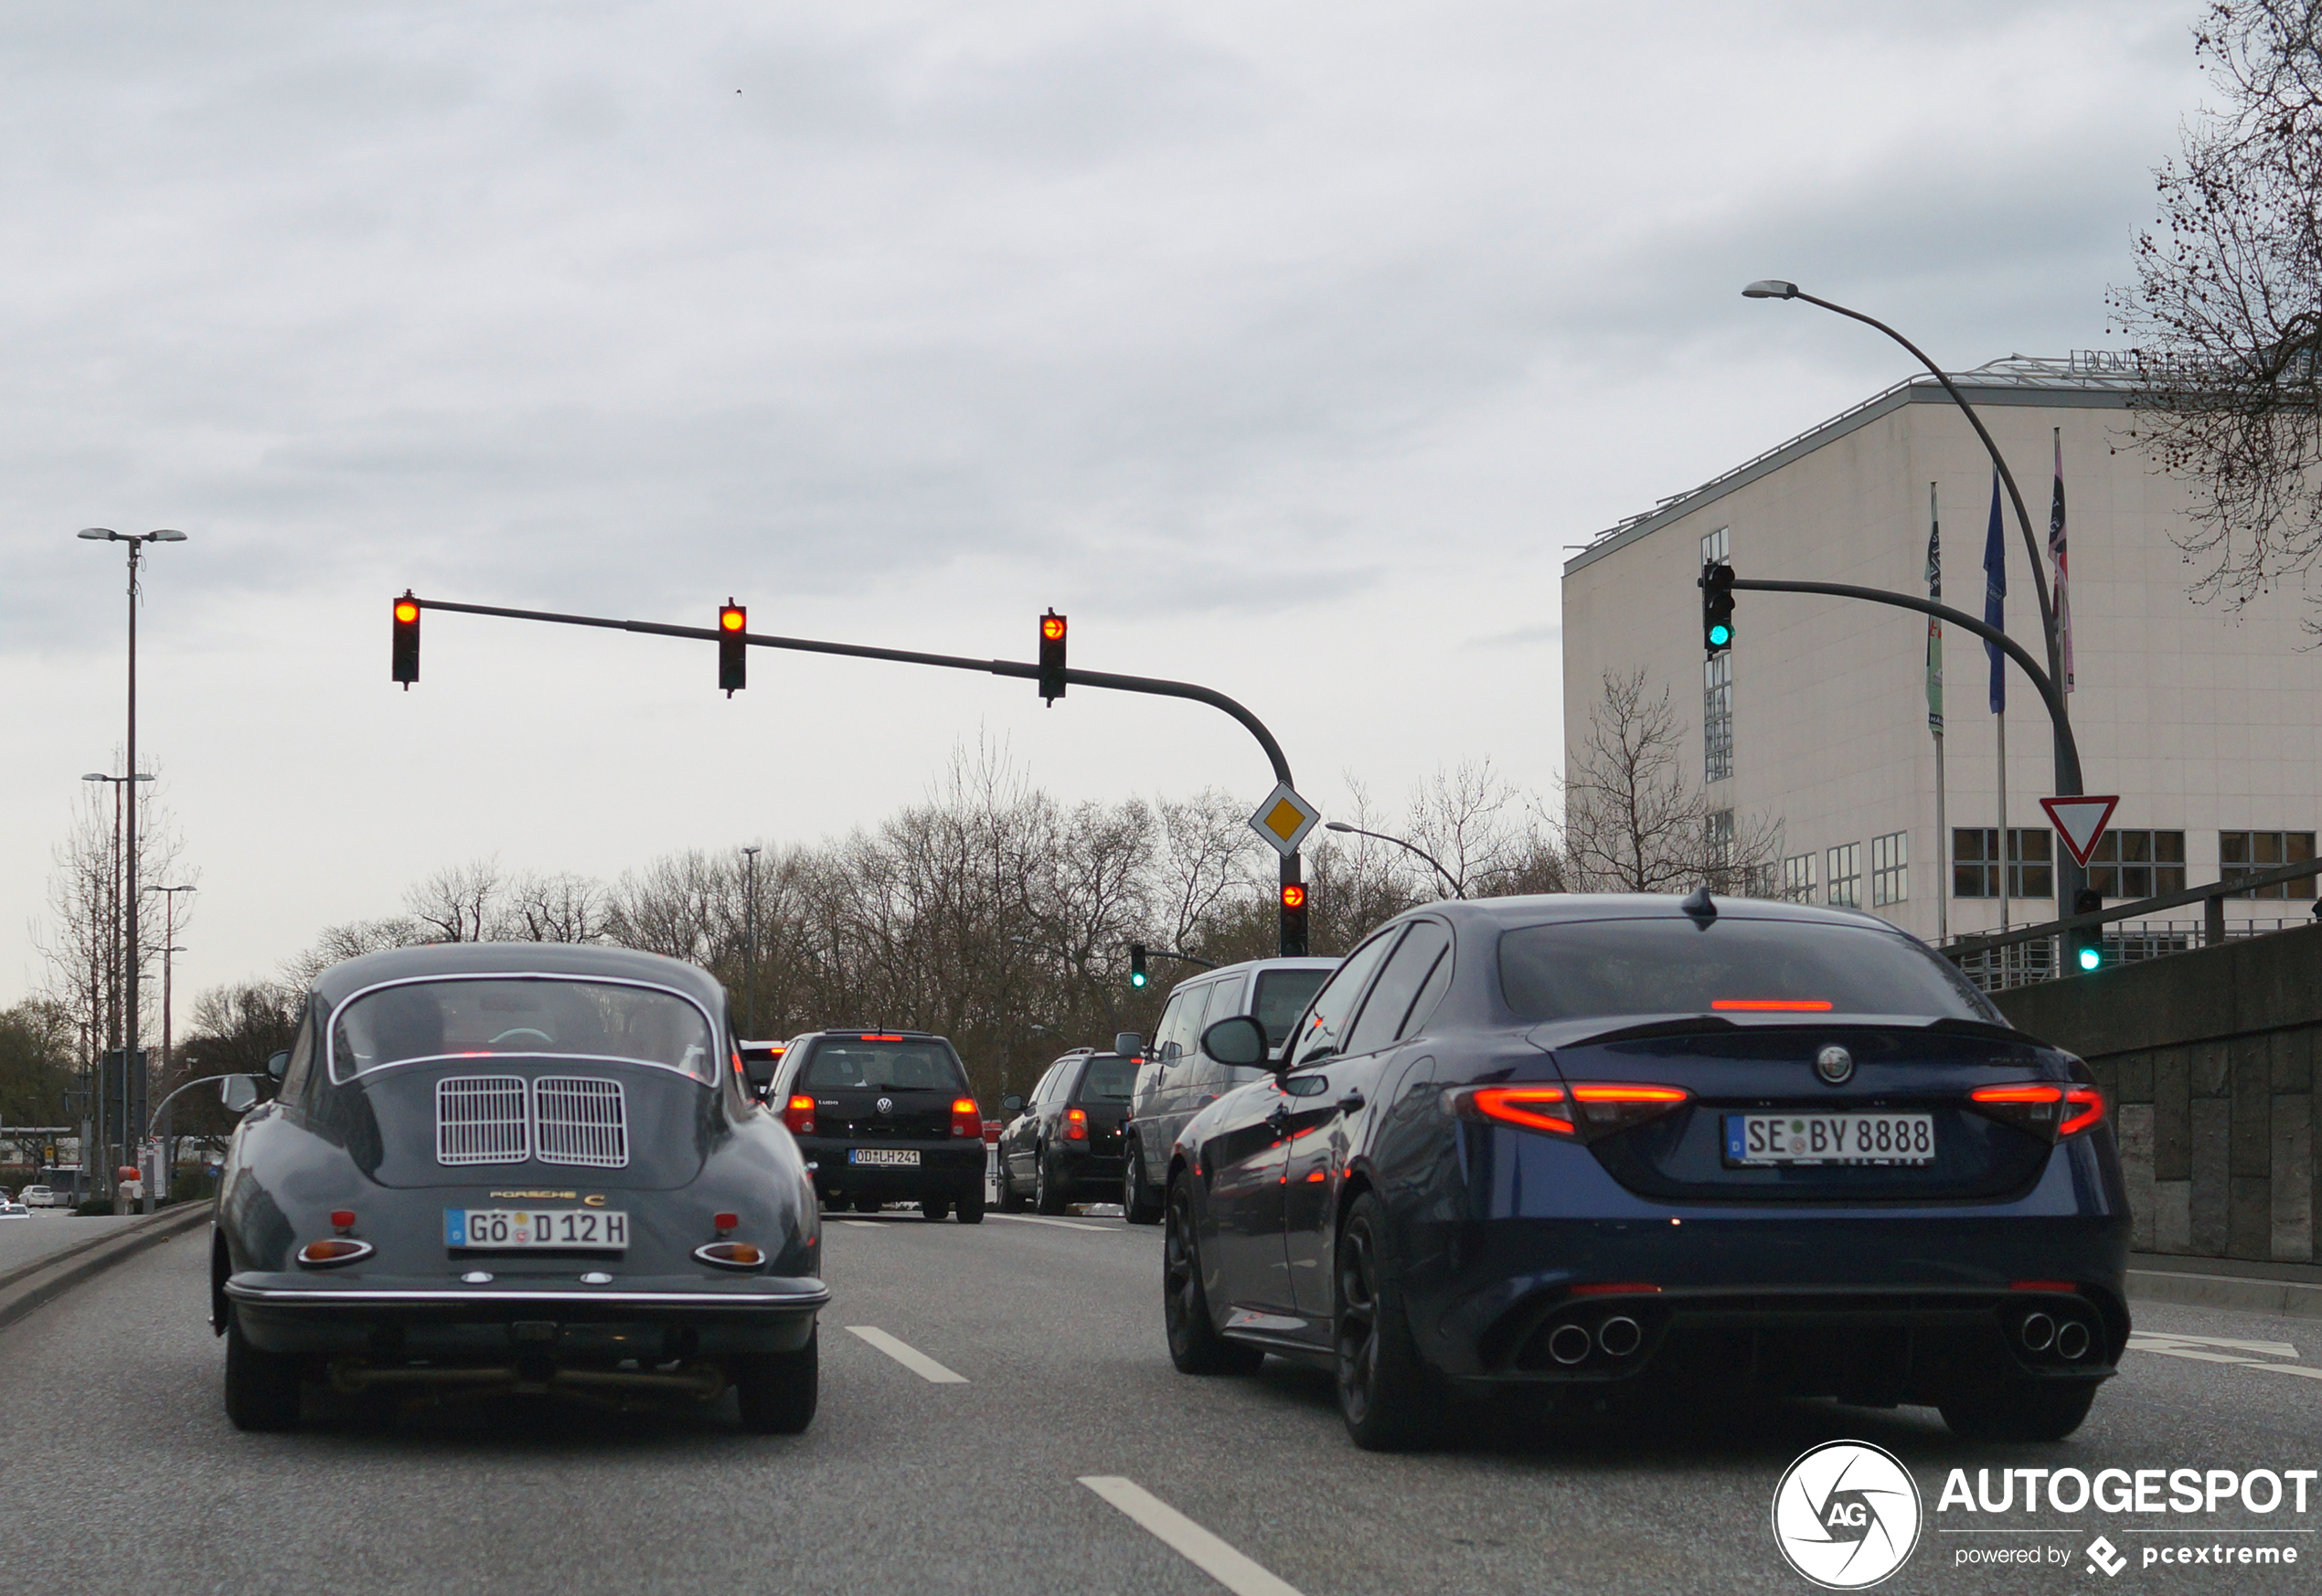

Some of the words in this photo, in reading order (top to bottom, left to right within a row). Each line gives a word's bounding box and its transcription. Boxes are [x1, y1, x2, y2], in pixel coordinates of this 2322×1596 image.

[1749, 1120, 1785, 1152] SE
[1811, 1120, 1847, 1152] BY
[1857, 1120, 1930, 1153] 8888
[857, 1151, 872, 1162] OD
[879, 1151, 895, 1163] LH
[897, 1152, 919, 1164] 241
[470, 1214, 507, 1241] GÖ
[534, 1214, 551, 1241] D
[560, 1214, 597, 1242] 12
[606, 1215, 624, 1242] H
